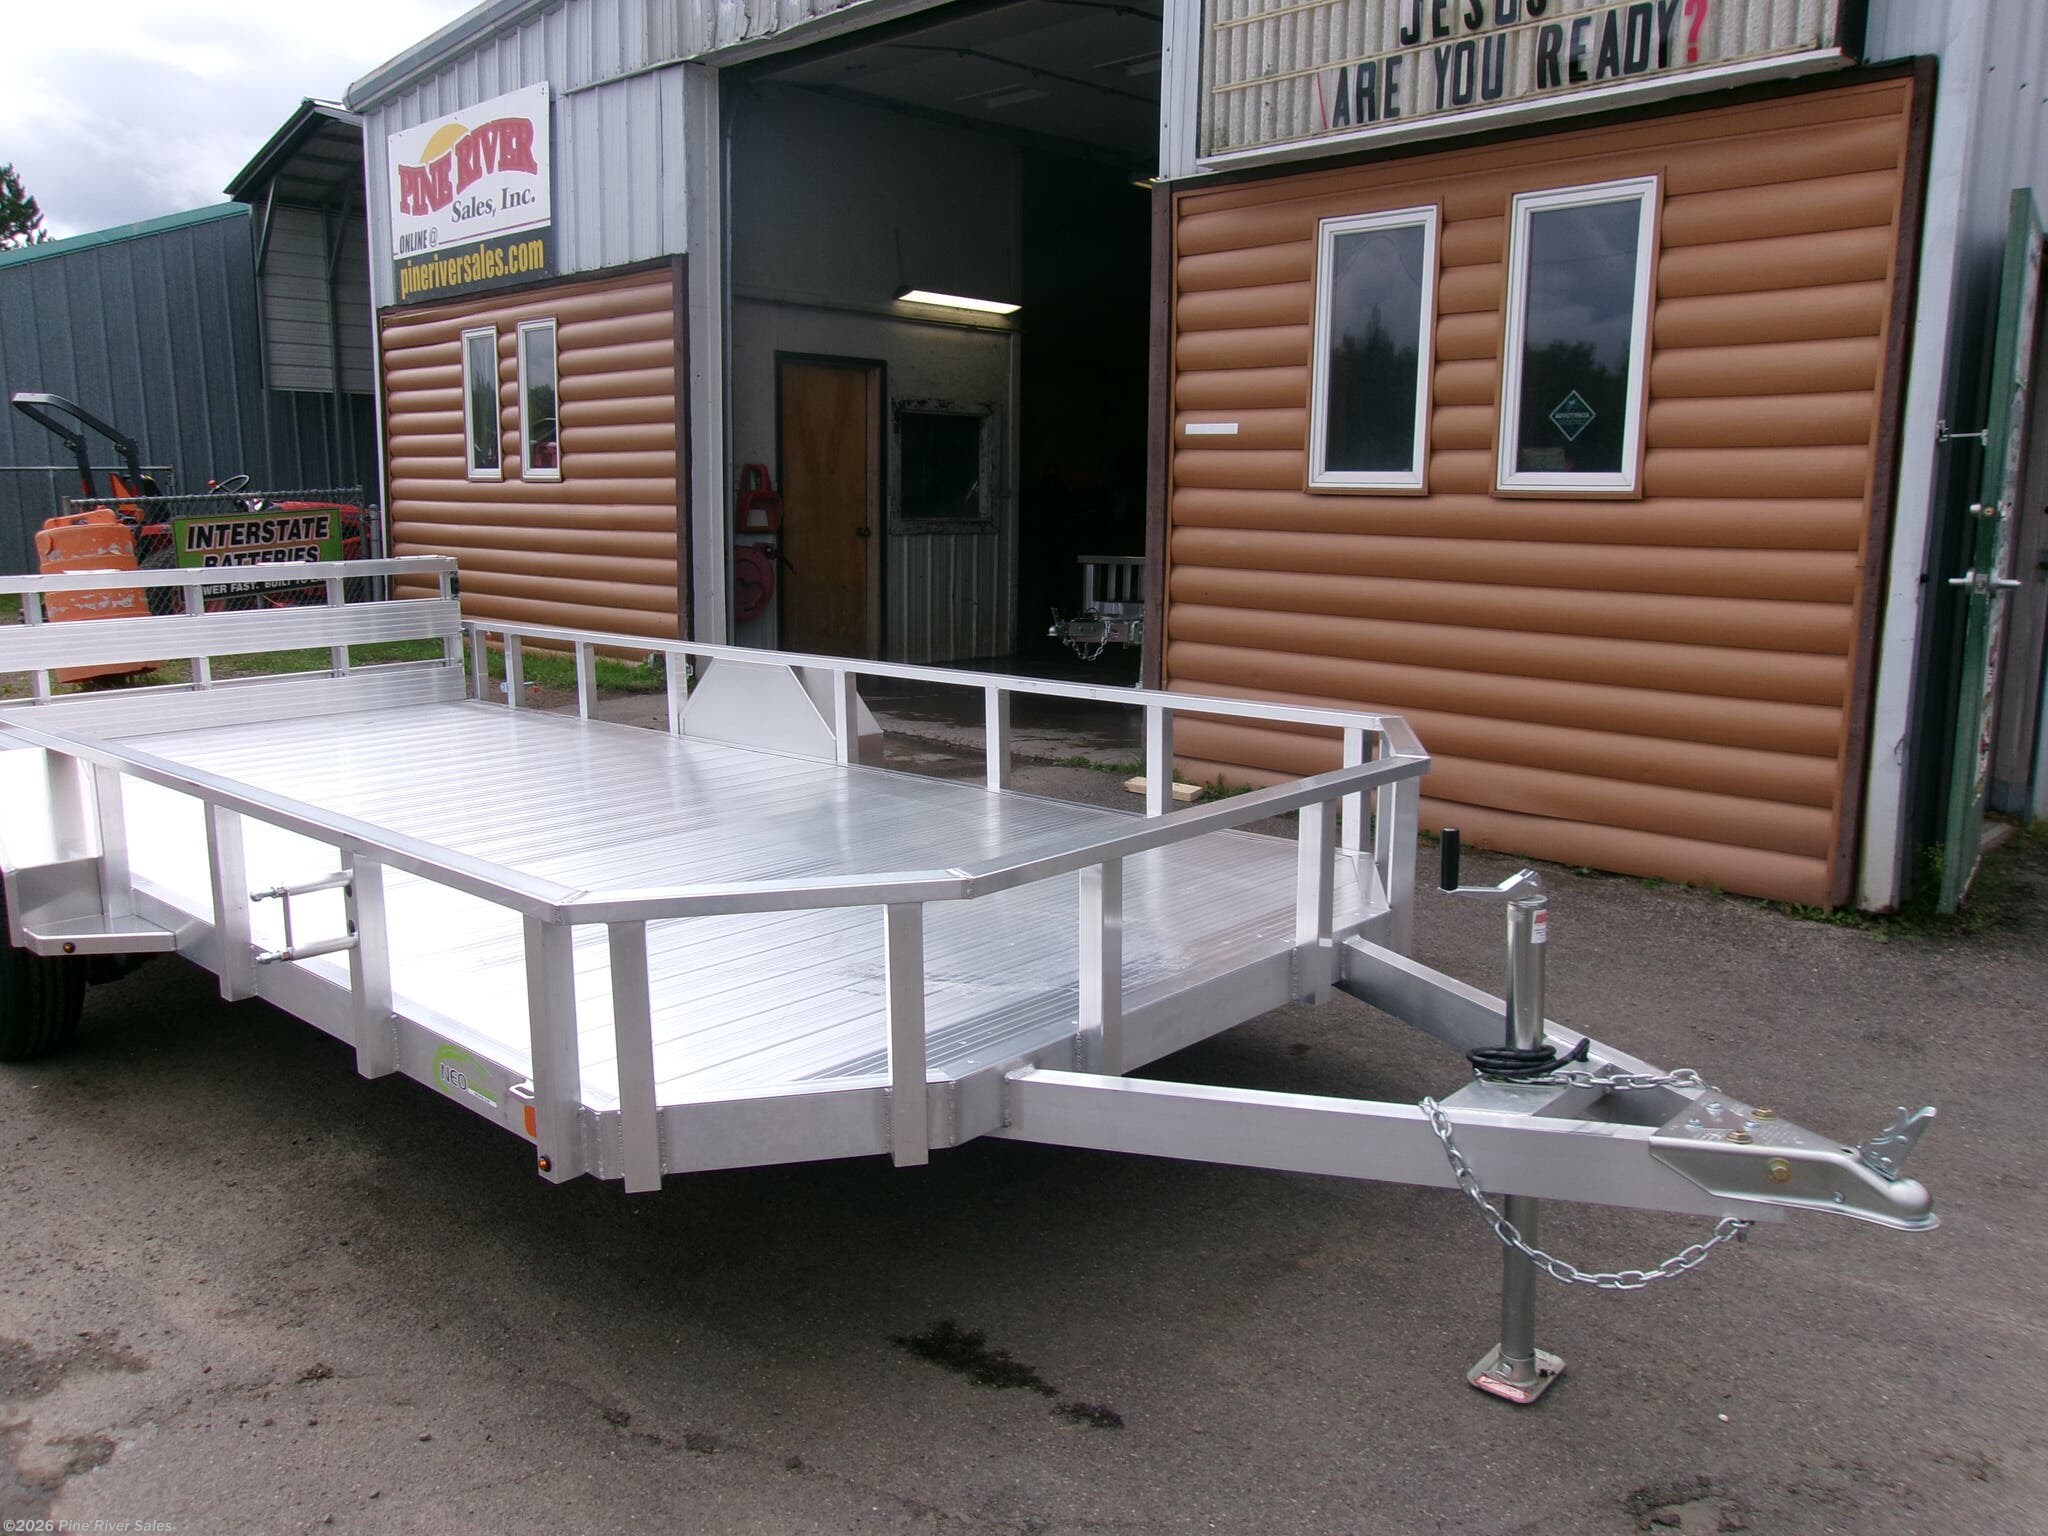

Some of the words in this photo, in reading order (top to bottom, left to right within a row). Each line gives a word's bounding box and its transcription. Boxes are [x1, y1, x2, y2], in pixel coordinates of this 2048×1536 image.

[1333, 55, 1402, 127] ARE
[1433, 33, 1506, 110] YOU
[398, 151, 454, 216] PINE
[453, 117, 538, 195] RIVER
[451, 197, 496, 223] Sales,
[501, 187, 536, 210] Inc.
[399, 229, 427, 254] ONLINE
[400, 239, 544, 299] pineriversales.com
[186, 515, 330, 551] INTERSTATE
[441, 1062, 468, 1091] NEO
